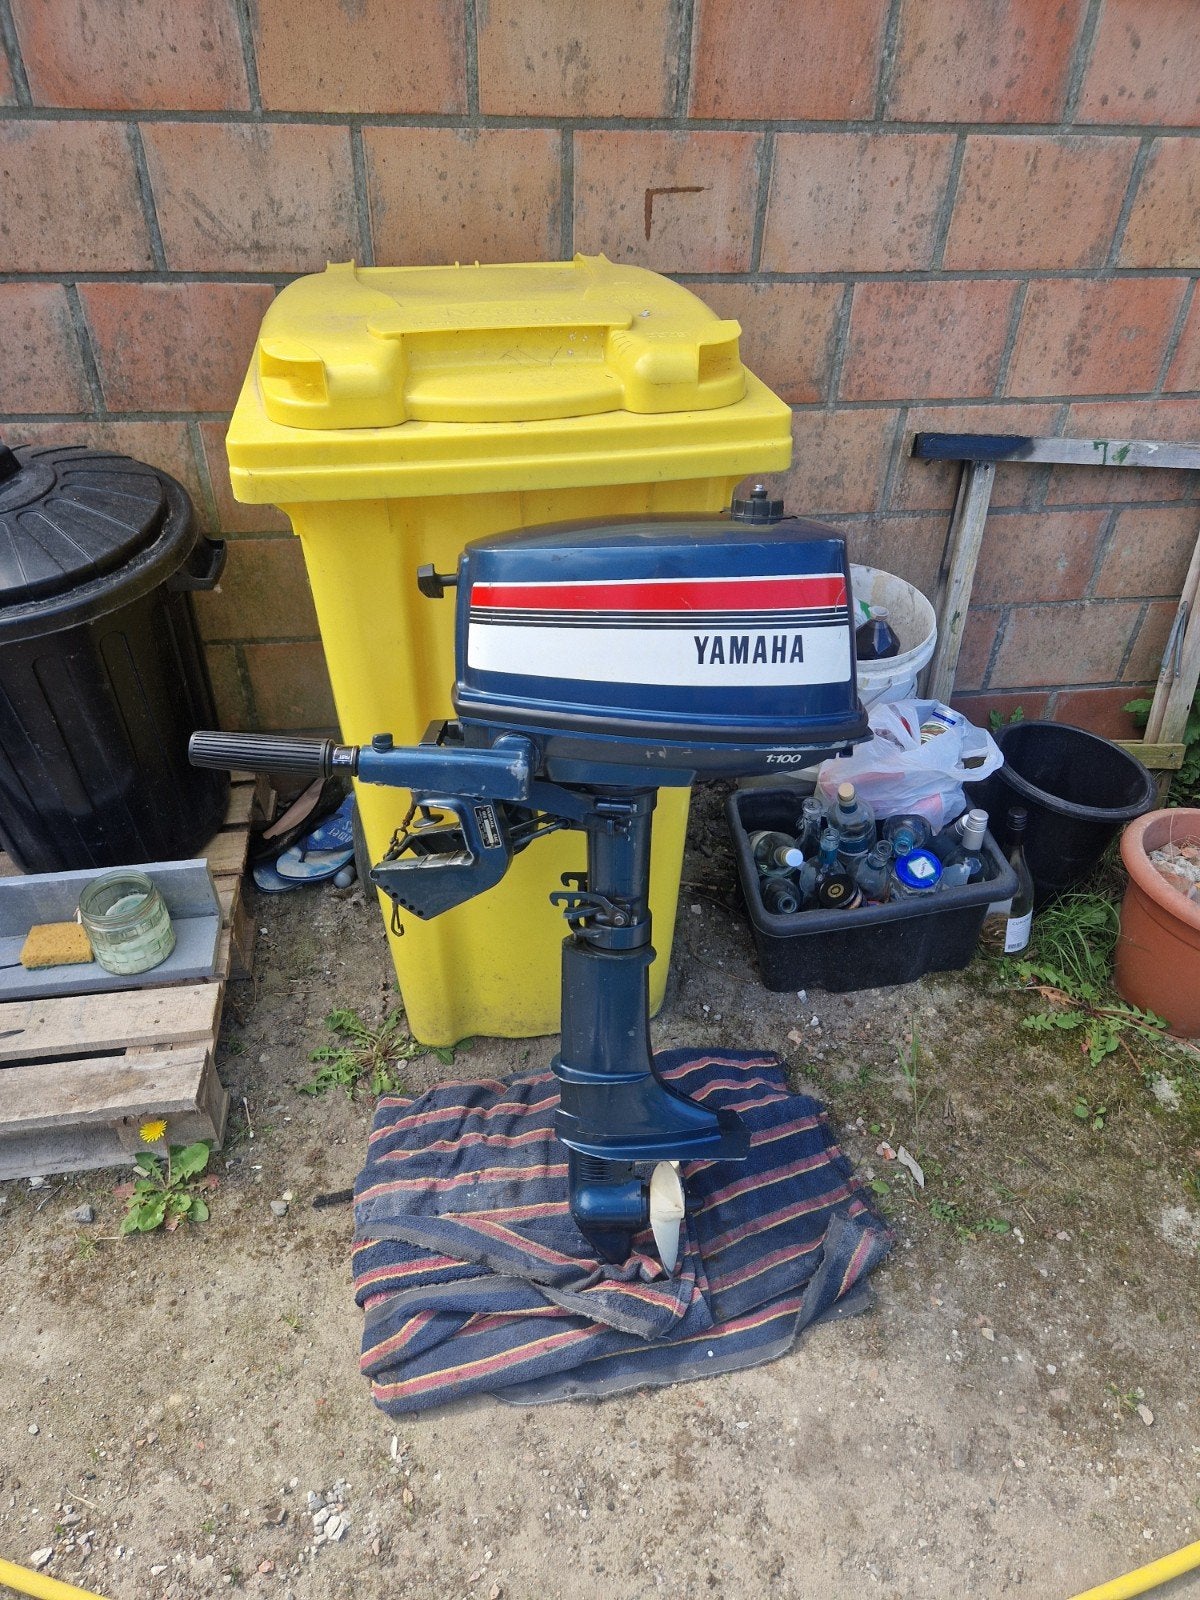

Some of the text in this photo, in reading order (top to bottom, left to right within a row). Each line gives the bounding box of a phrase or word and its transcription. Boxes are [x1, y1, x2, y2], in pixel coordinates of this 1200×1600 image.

[694, 635, 804, 664] YAMAHA
[766, 754, 802, 764] 1:100
[486, 807, 495, 828] YAMAHA
